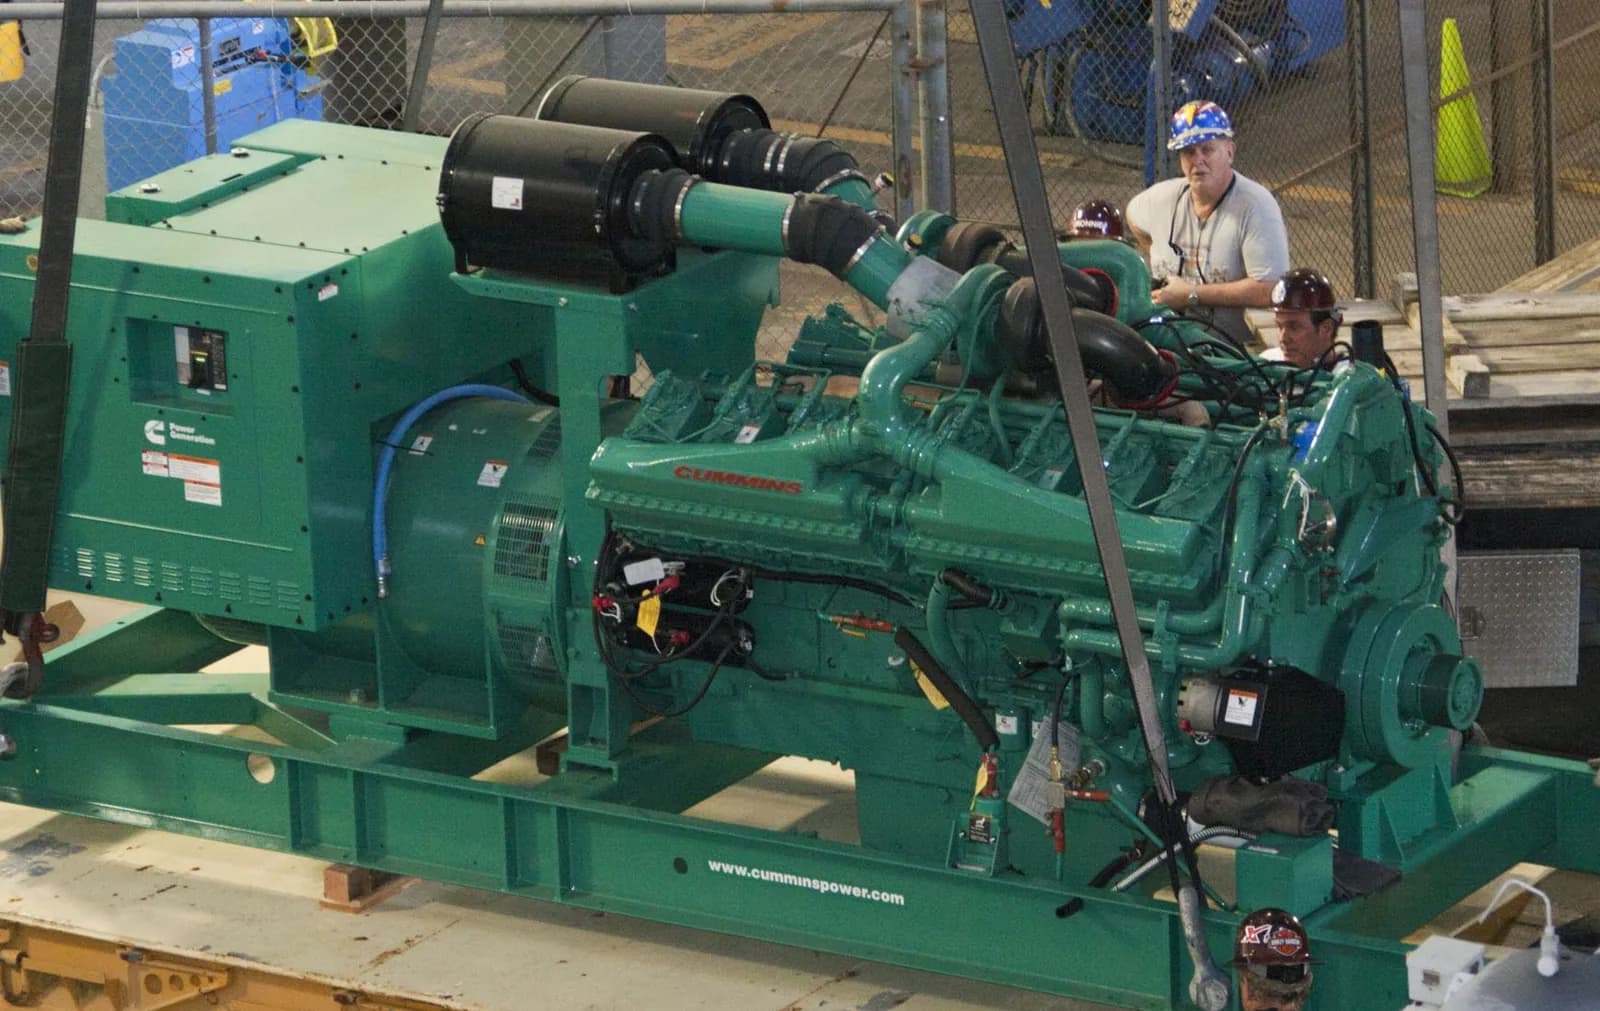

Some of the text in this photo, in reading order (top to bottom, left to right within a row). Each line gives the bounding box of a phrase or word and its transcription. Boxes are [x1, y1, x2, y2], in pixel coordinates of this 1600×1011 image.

[169, 422, 195, 434] Power
[169, 430, 216, 445] Generation
[674, 465, 801, 495] CUMMINS
[707, 860, 905, 906] www.cumminspower.com
